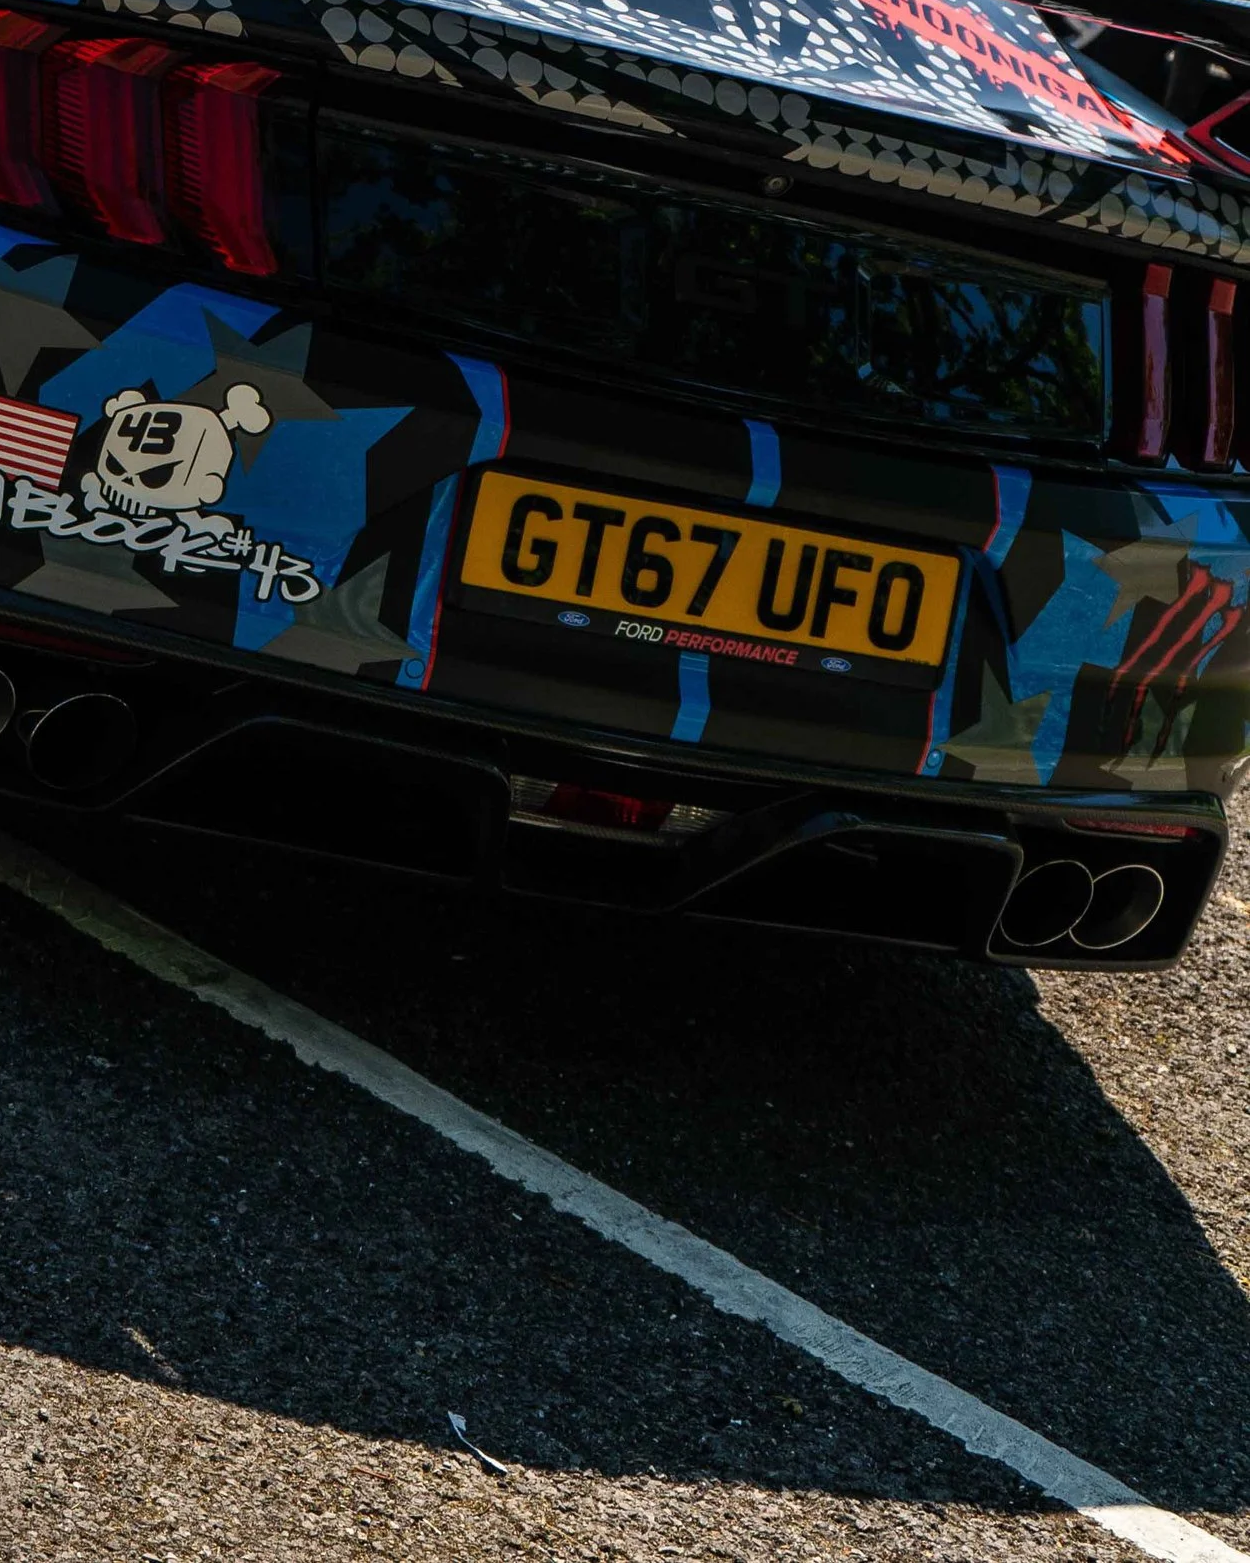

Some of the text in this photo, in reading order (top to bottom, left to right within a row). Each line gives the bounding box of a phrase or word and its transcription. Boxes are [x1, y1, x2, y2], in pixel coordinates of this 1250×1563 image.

[117, 411, 183, 456] 43
[8, 480, 246, 575] BLOCK
[223, 529, 321, 604] #43
[499, 492, 927, 652] GT67 UFO
[615, 620, 799, 666] FORD PERFORMANCE
